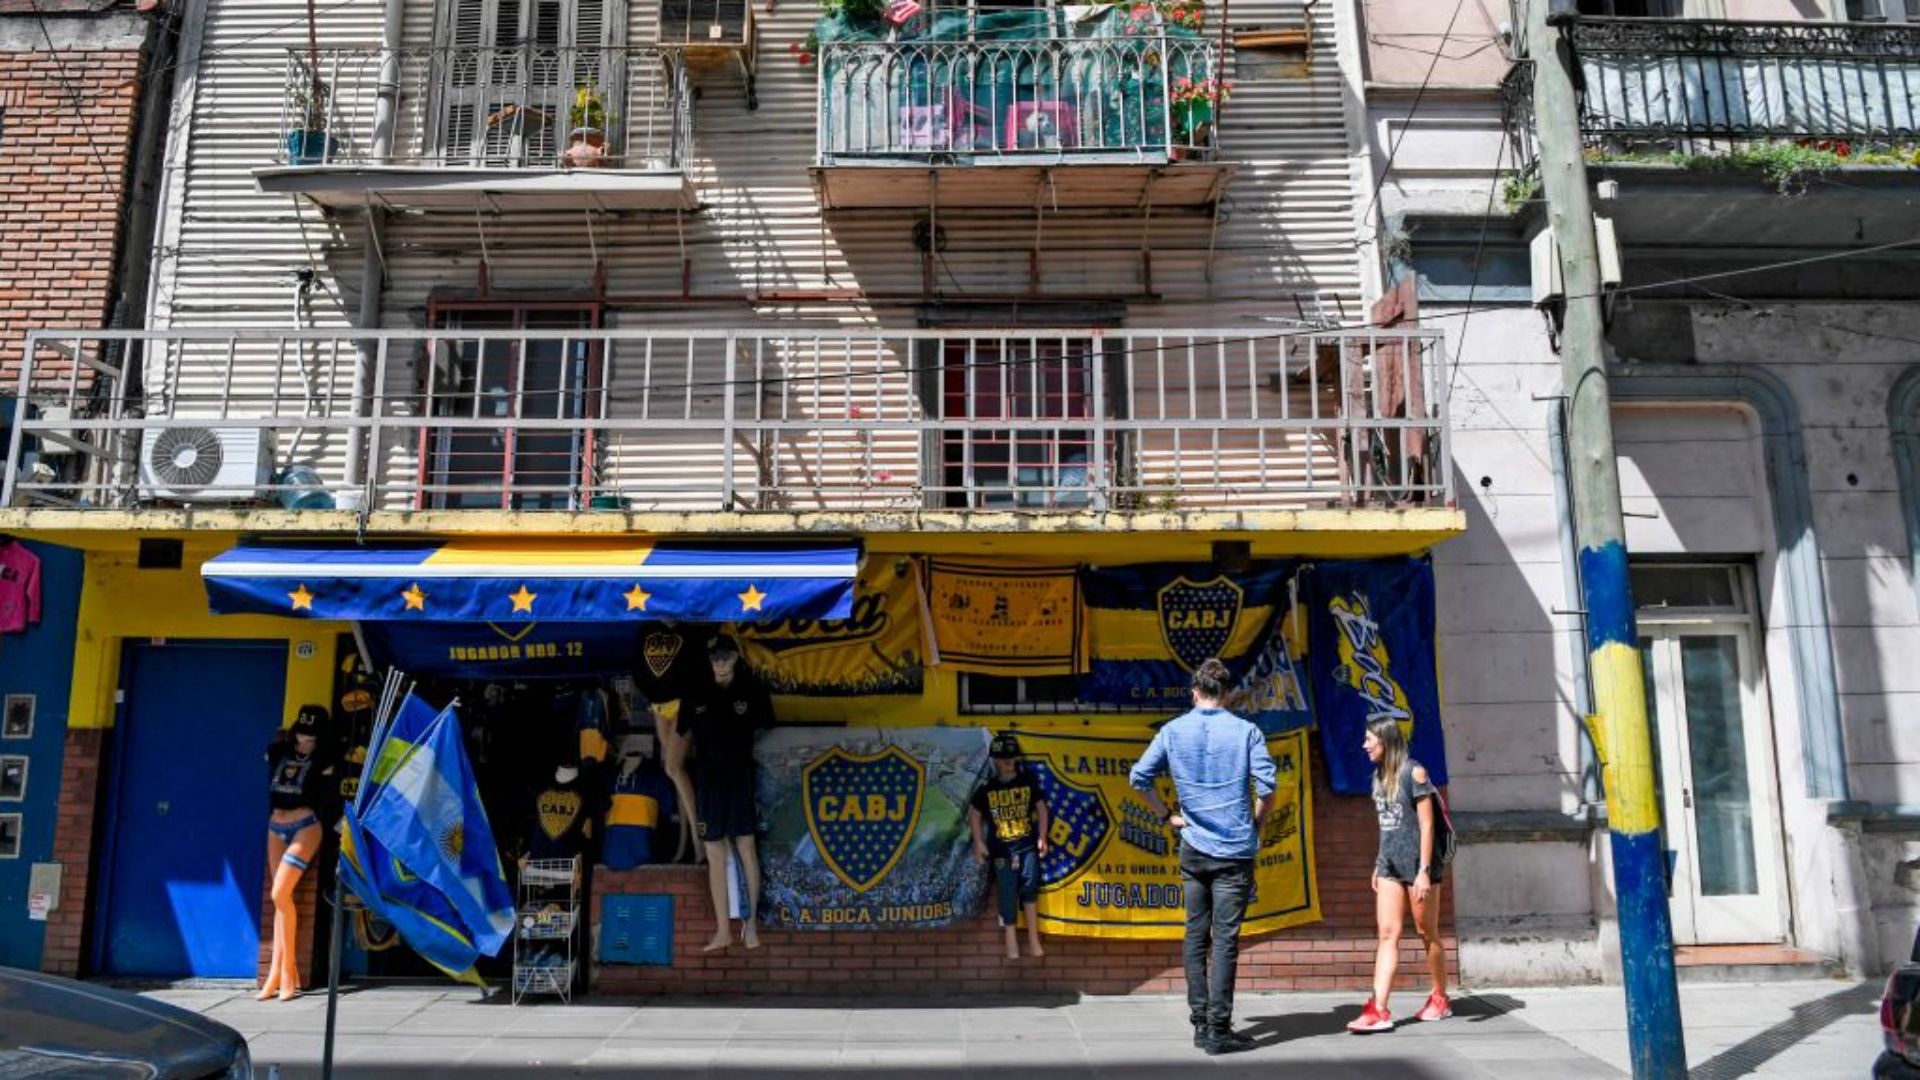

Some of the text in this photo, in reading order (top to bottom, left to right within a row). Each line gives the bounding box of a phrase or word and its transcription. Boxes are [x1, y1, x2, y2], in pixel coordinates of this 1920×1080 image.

[1168, 609, 1231, 629] CABJ
[449, 645, 521, 660] JUGADOR
[566, 641, 583, 656] 12
[1063, 754, 1091, 774] LA
[541, 803, 575, 817] CABJ
[817, 794, 908, 822] CABJ
[1097, 863, 1113, 875] LA
[1130, 863, 1167, 875] UNIDA
[1077, 881, 1185, 909] JUGADO
[780, 901, 952, 923] C. A. BOCA JUNIORS
